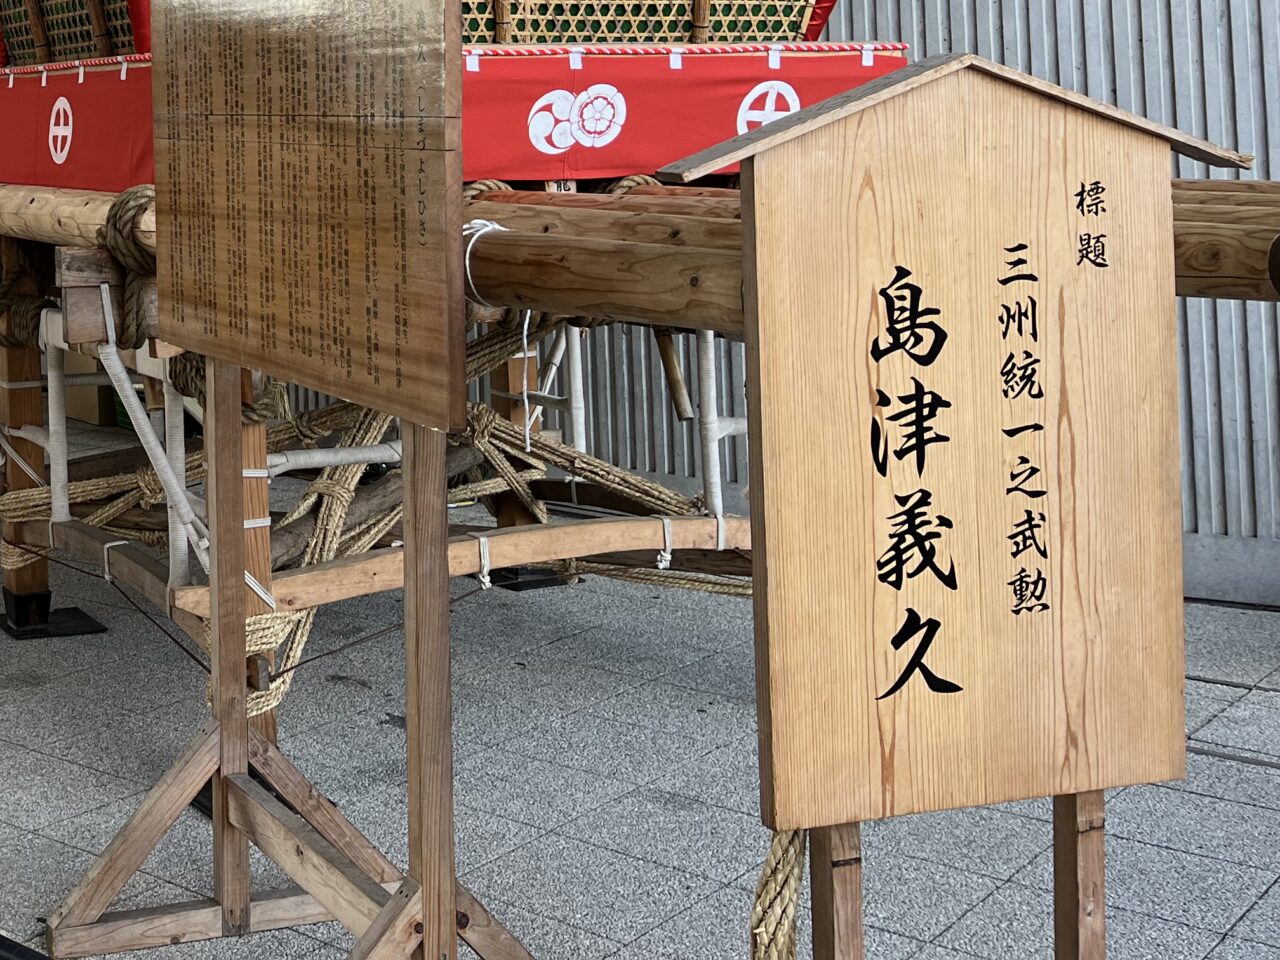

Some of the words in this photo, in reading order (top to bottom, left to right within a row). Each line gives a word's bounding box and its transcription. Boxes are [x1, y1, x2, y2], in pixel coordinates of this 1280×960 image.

[1074, 181, 1109, 269] 標題
[869, 265, 964, 701] 島津義久
[996, 242, 1050, 616] 三州統一之武勲
